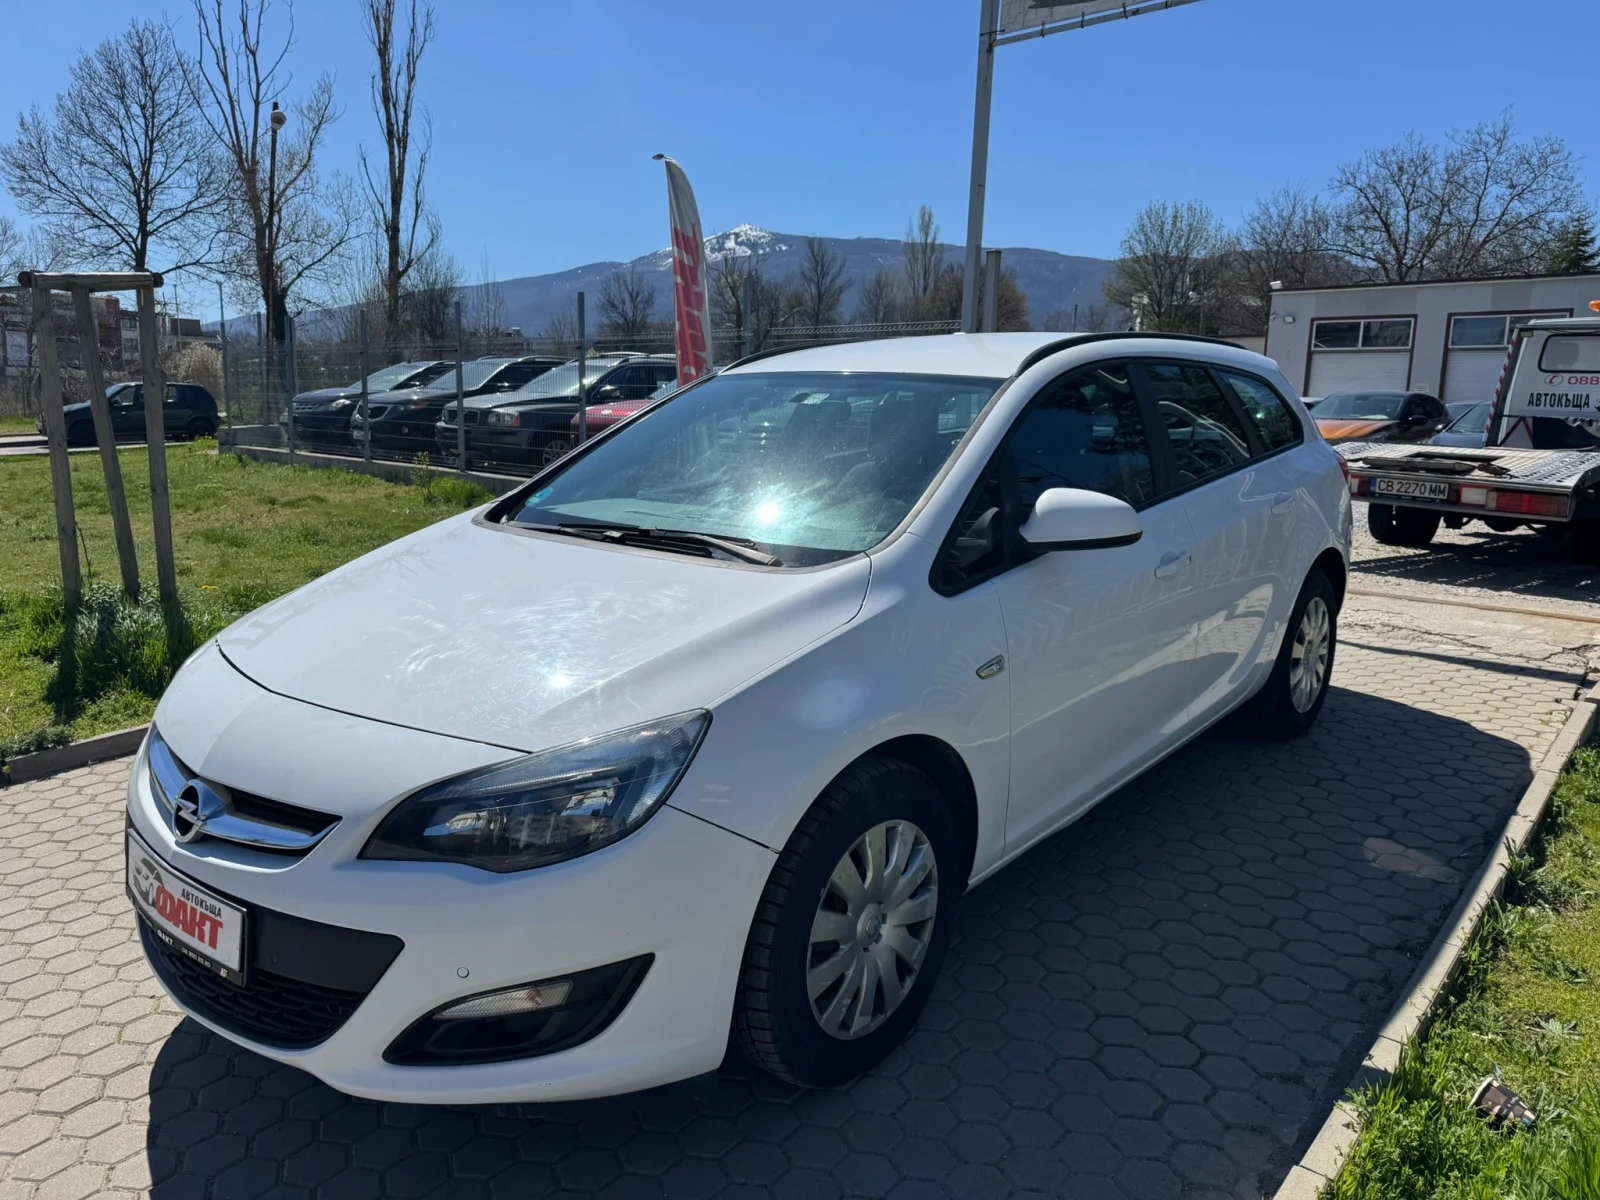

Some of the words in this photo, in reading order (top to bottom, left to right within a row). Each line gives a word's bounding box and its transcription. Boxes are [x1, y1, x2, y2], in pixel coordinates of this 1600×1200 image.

[1527, 392, 1590, 410] АВТОКЪЩА
[1378, 480, 1394, 492] CB
[1397, 481, 1427, 495] 2270
[1428, 484, 1447, 497] MM
[181, 888, 222, 918] АВТОКЪЩА
[155, 885, 224, 950] ФАКТ
